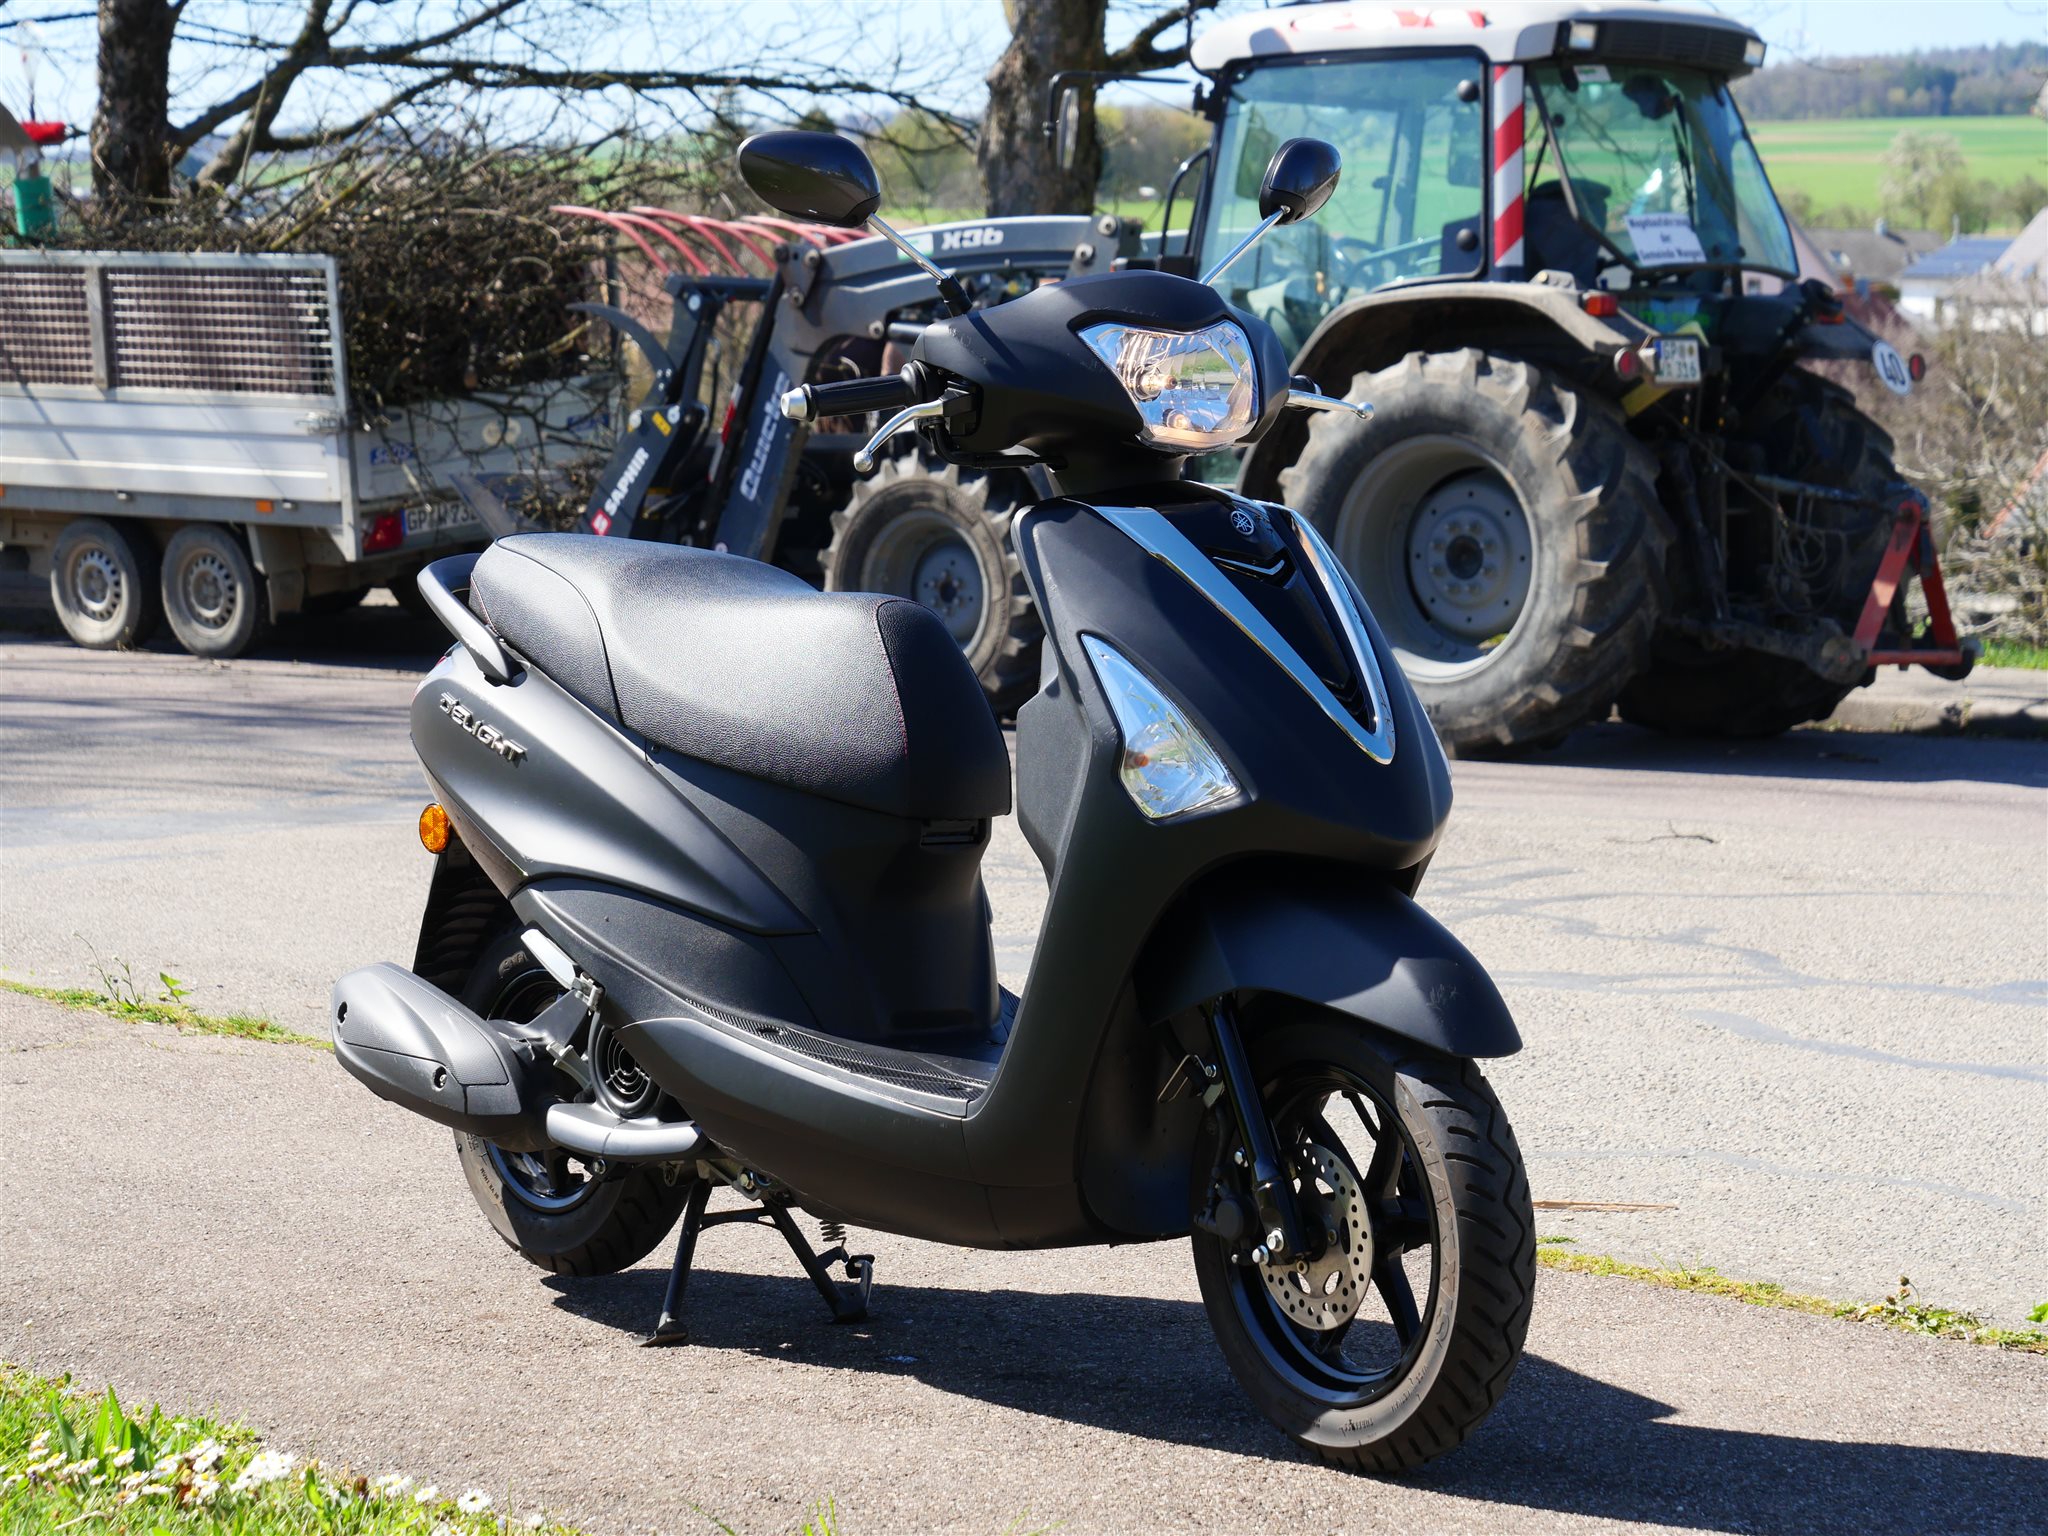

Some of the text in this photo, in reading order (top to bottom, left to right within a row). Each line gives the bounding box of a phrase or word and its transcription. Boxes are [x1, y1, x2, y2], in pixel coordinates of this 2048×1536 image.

[1880, 351, 1906, 385] 40
[604, 447, 650, 516] SAPHIR
[439, 691, 527, 762] DELIGHT
